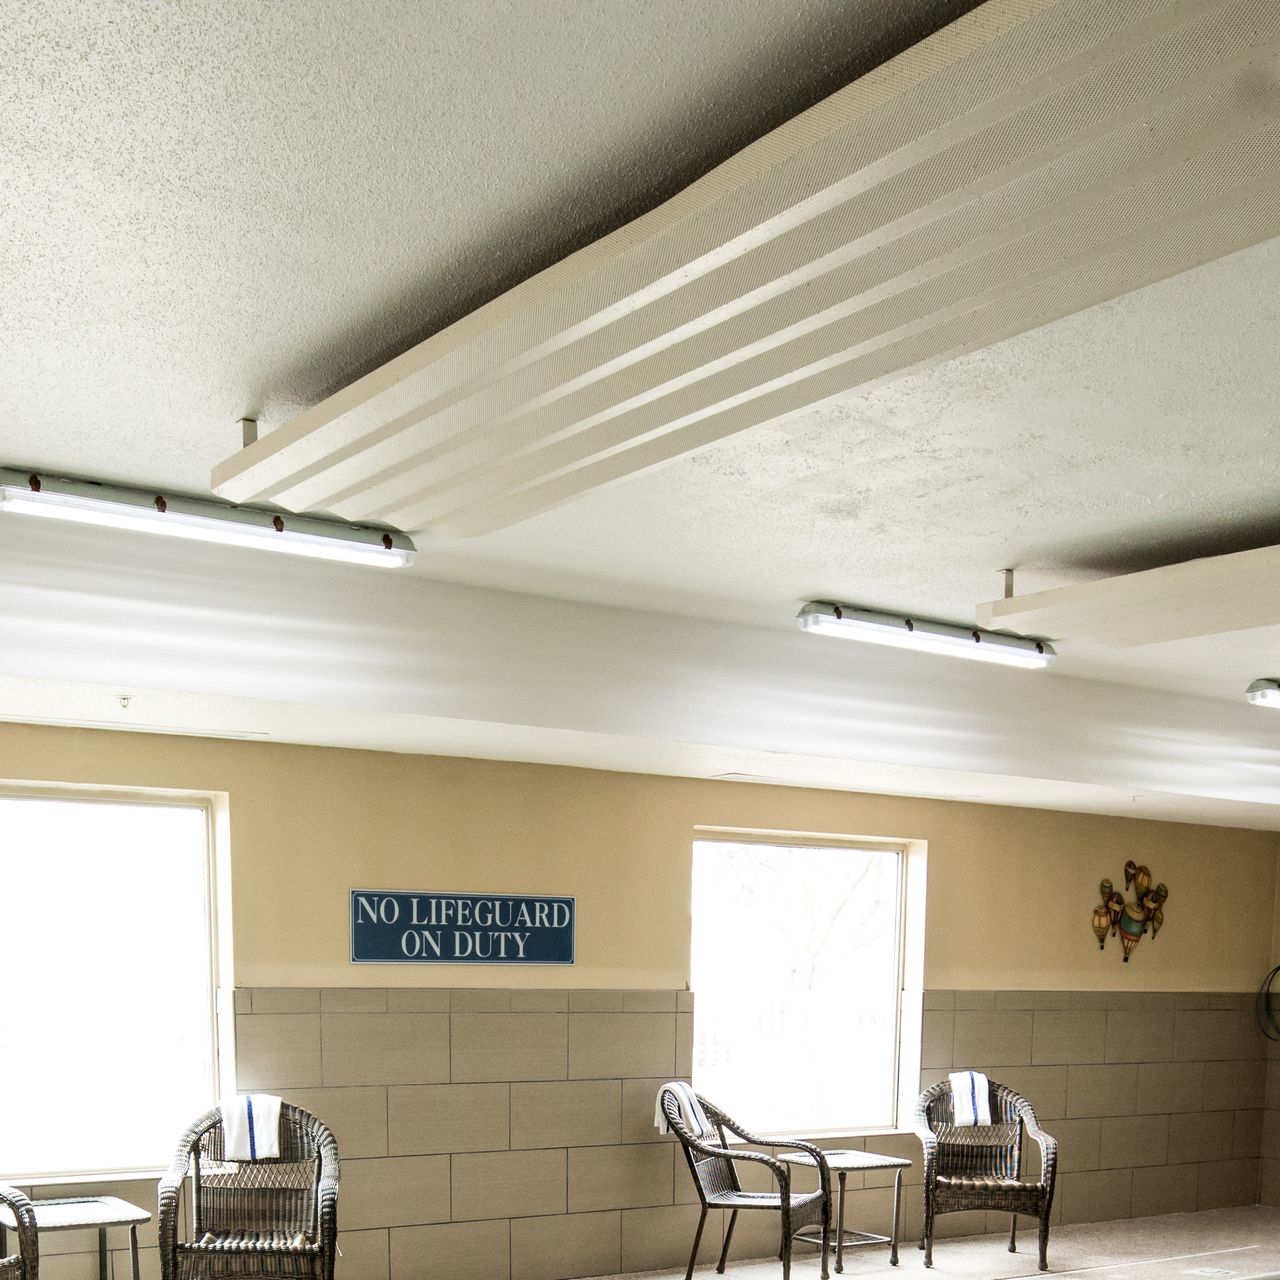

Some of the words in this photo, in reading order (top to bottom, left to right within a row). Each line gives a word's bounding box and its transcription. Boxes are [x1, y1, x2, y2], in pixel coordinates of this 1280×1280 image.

[357, 897, 399, 924] NO
[410, 898, 570, 928] LIFEGUARD
[401, 930, 442, 957] ON
[453, 931, 531, 958] DUTY
